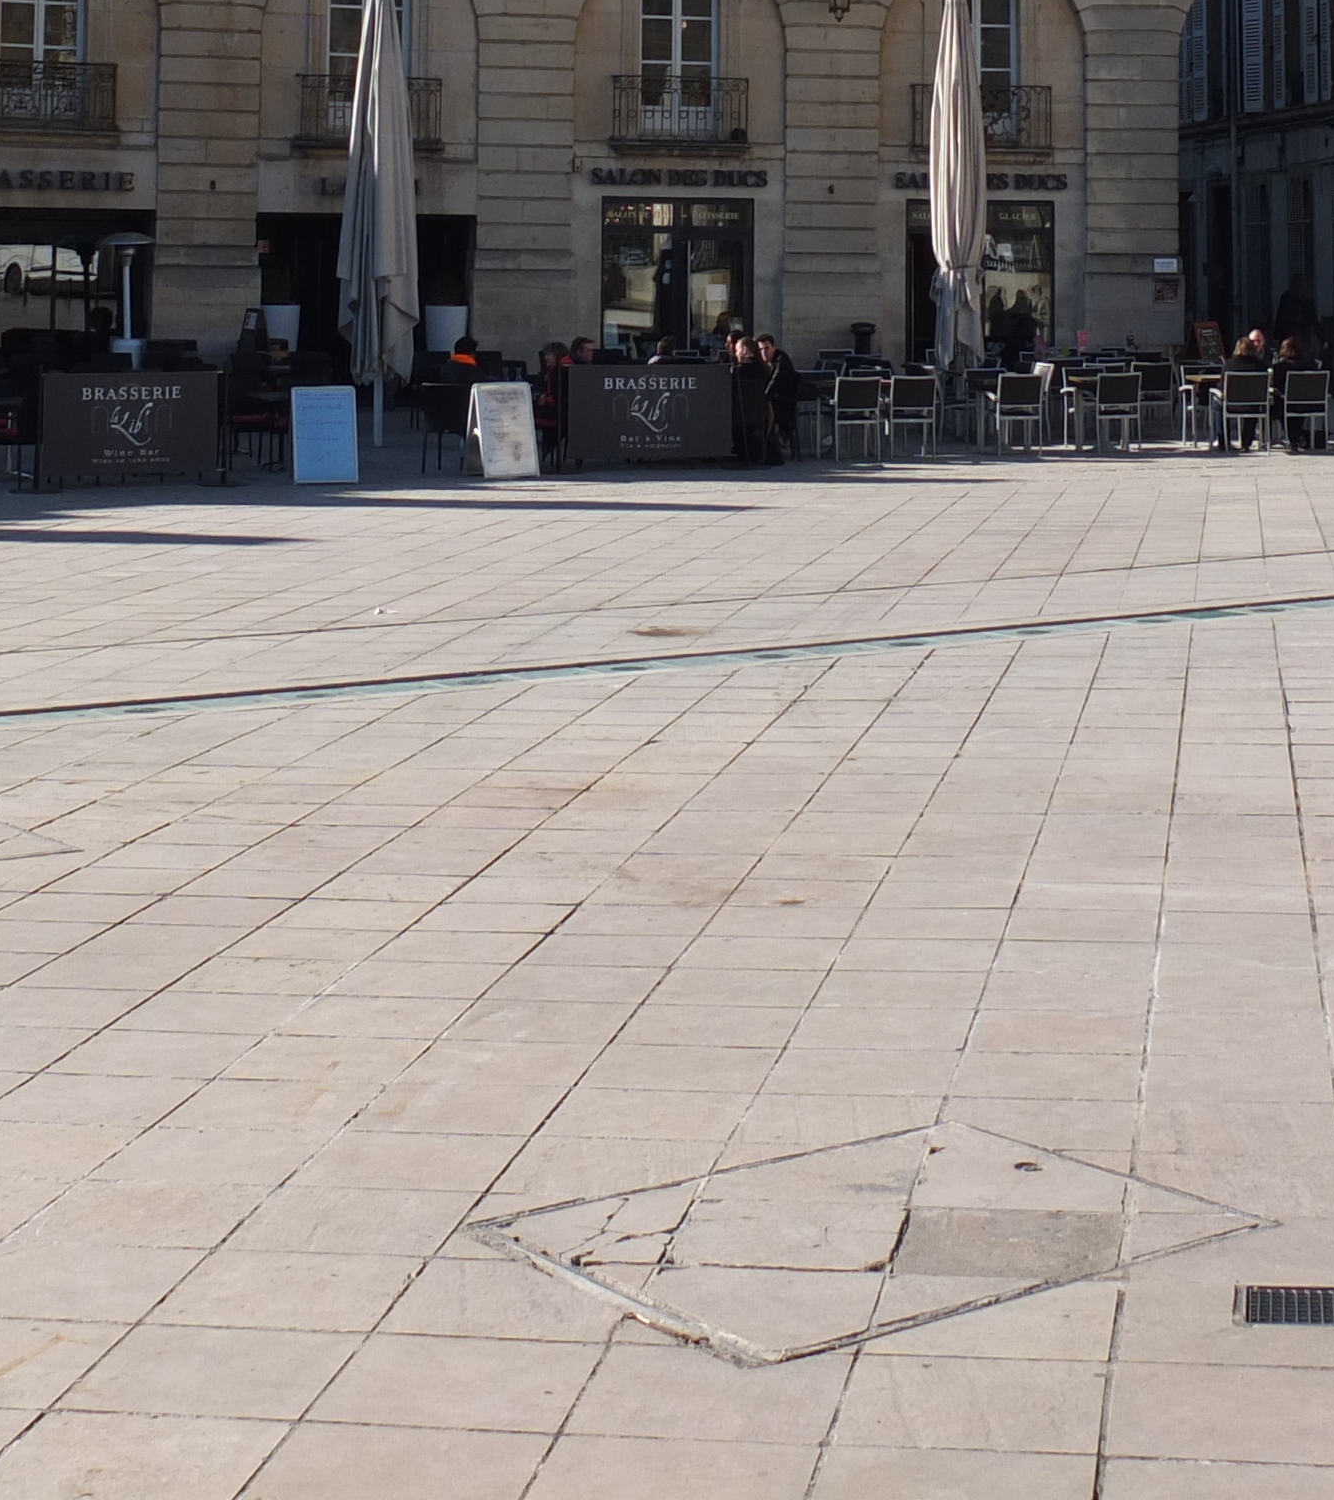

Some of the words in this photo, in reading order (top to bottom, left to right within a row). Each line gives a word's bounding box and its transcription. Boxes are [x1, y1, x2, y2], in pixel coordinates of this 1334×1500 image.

[592, 167, 661, 186] SALON
[668, 169, 707, 186] DES
[712, 170, 768, 187] DUCS
[1014, 174, 1068, 190] DUCS
[604, 377, 697, 390] BRASSERIE
[82, 386, 182, 401] BRASSERIE
